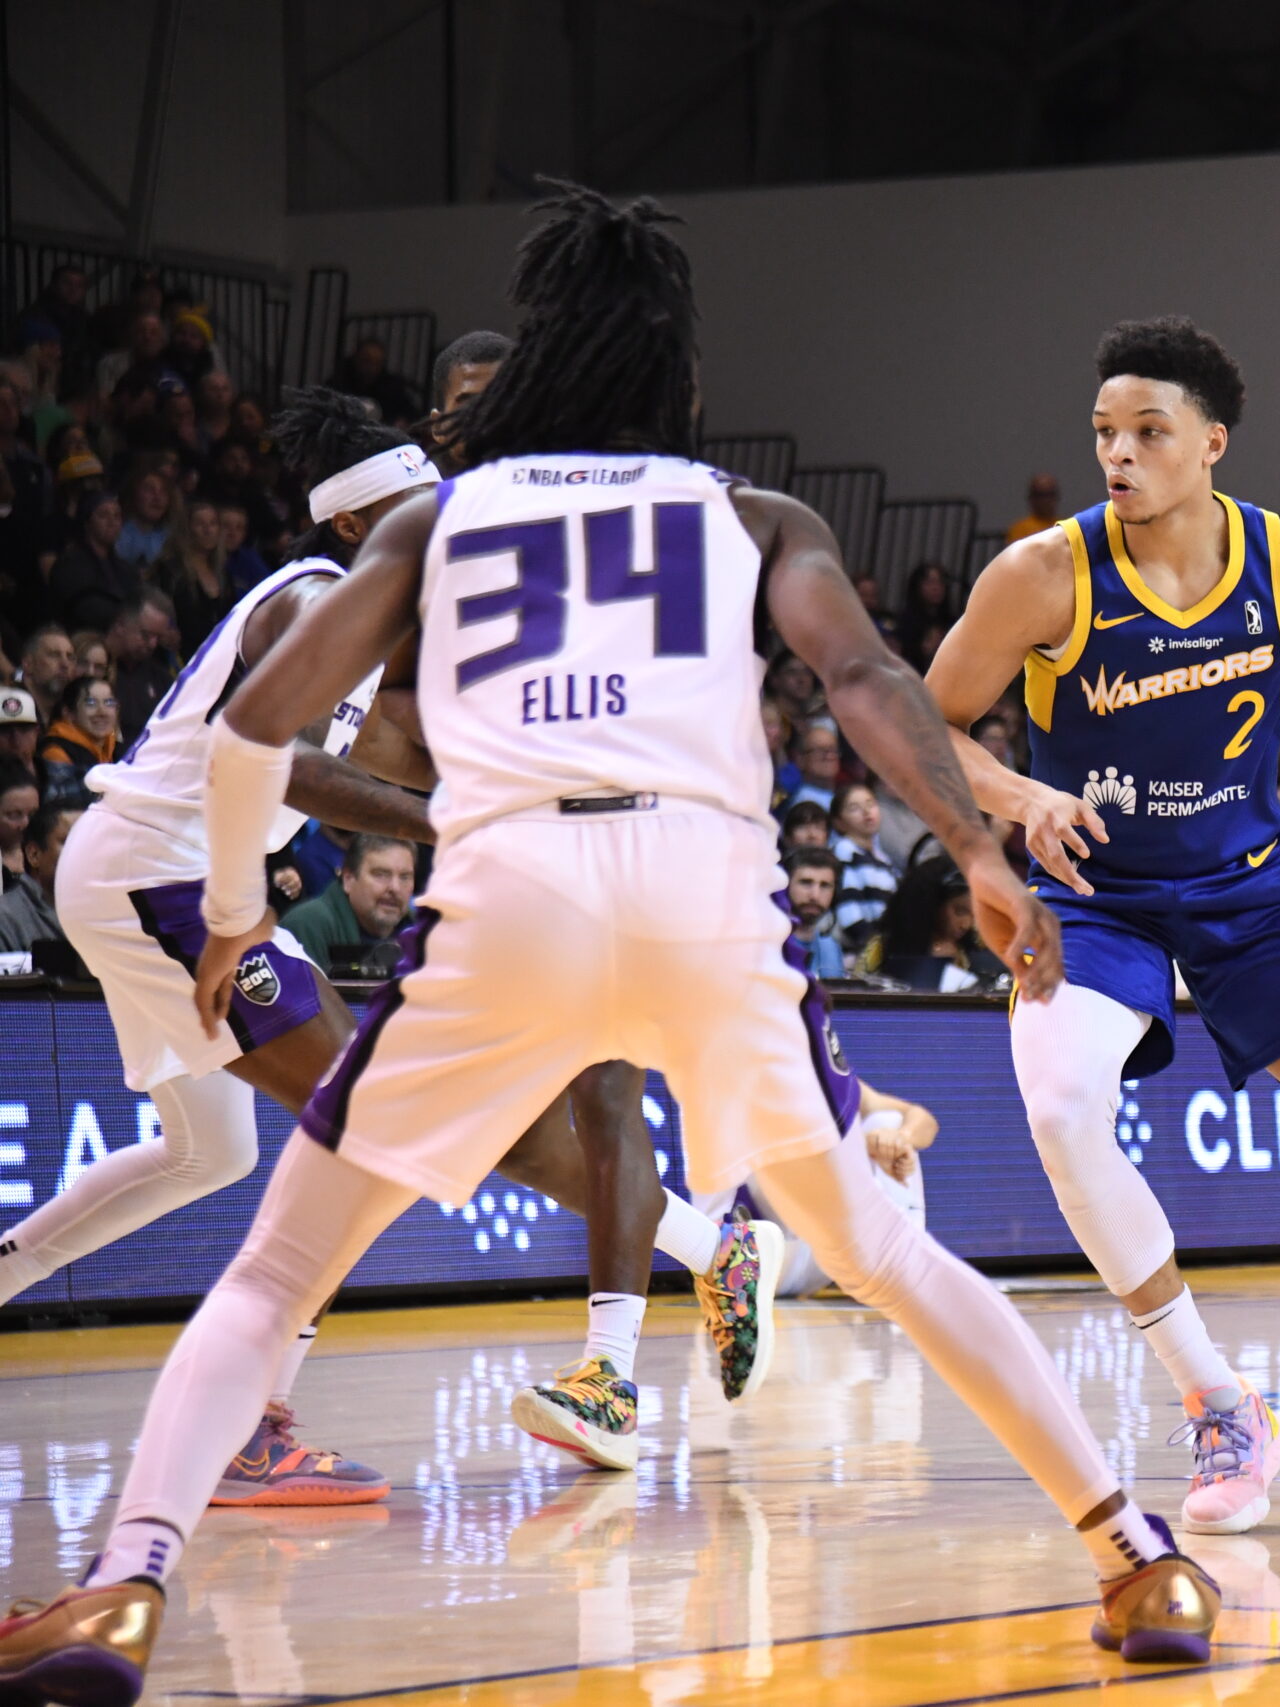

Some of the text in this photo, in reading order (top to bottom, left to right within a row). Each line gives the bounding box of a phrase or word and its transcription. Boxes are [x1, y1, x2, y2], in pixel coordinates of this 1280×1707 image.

[528, 468, 562, 487] NBA
[446, 501, 708, 695] 34
[1168, 637, 1220, 650] invisalign
[1080, 644, 1274, 716] WARRIORS
[522, 673, 628, 725] ELLIS
[1224, 690, 1265, 760] 2
[1147, 785, 1247, 817] PERMANENTE
[1148, 780, 1203, 797] KAISER
[239, 967, 273, 992] 209
